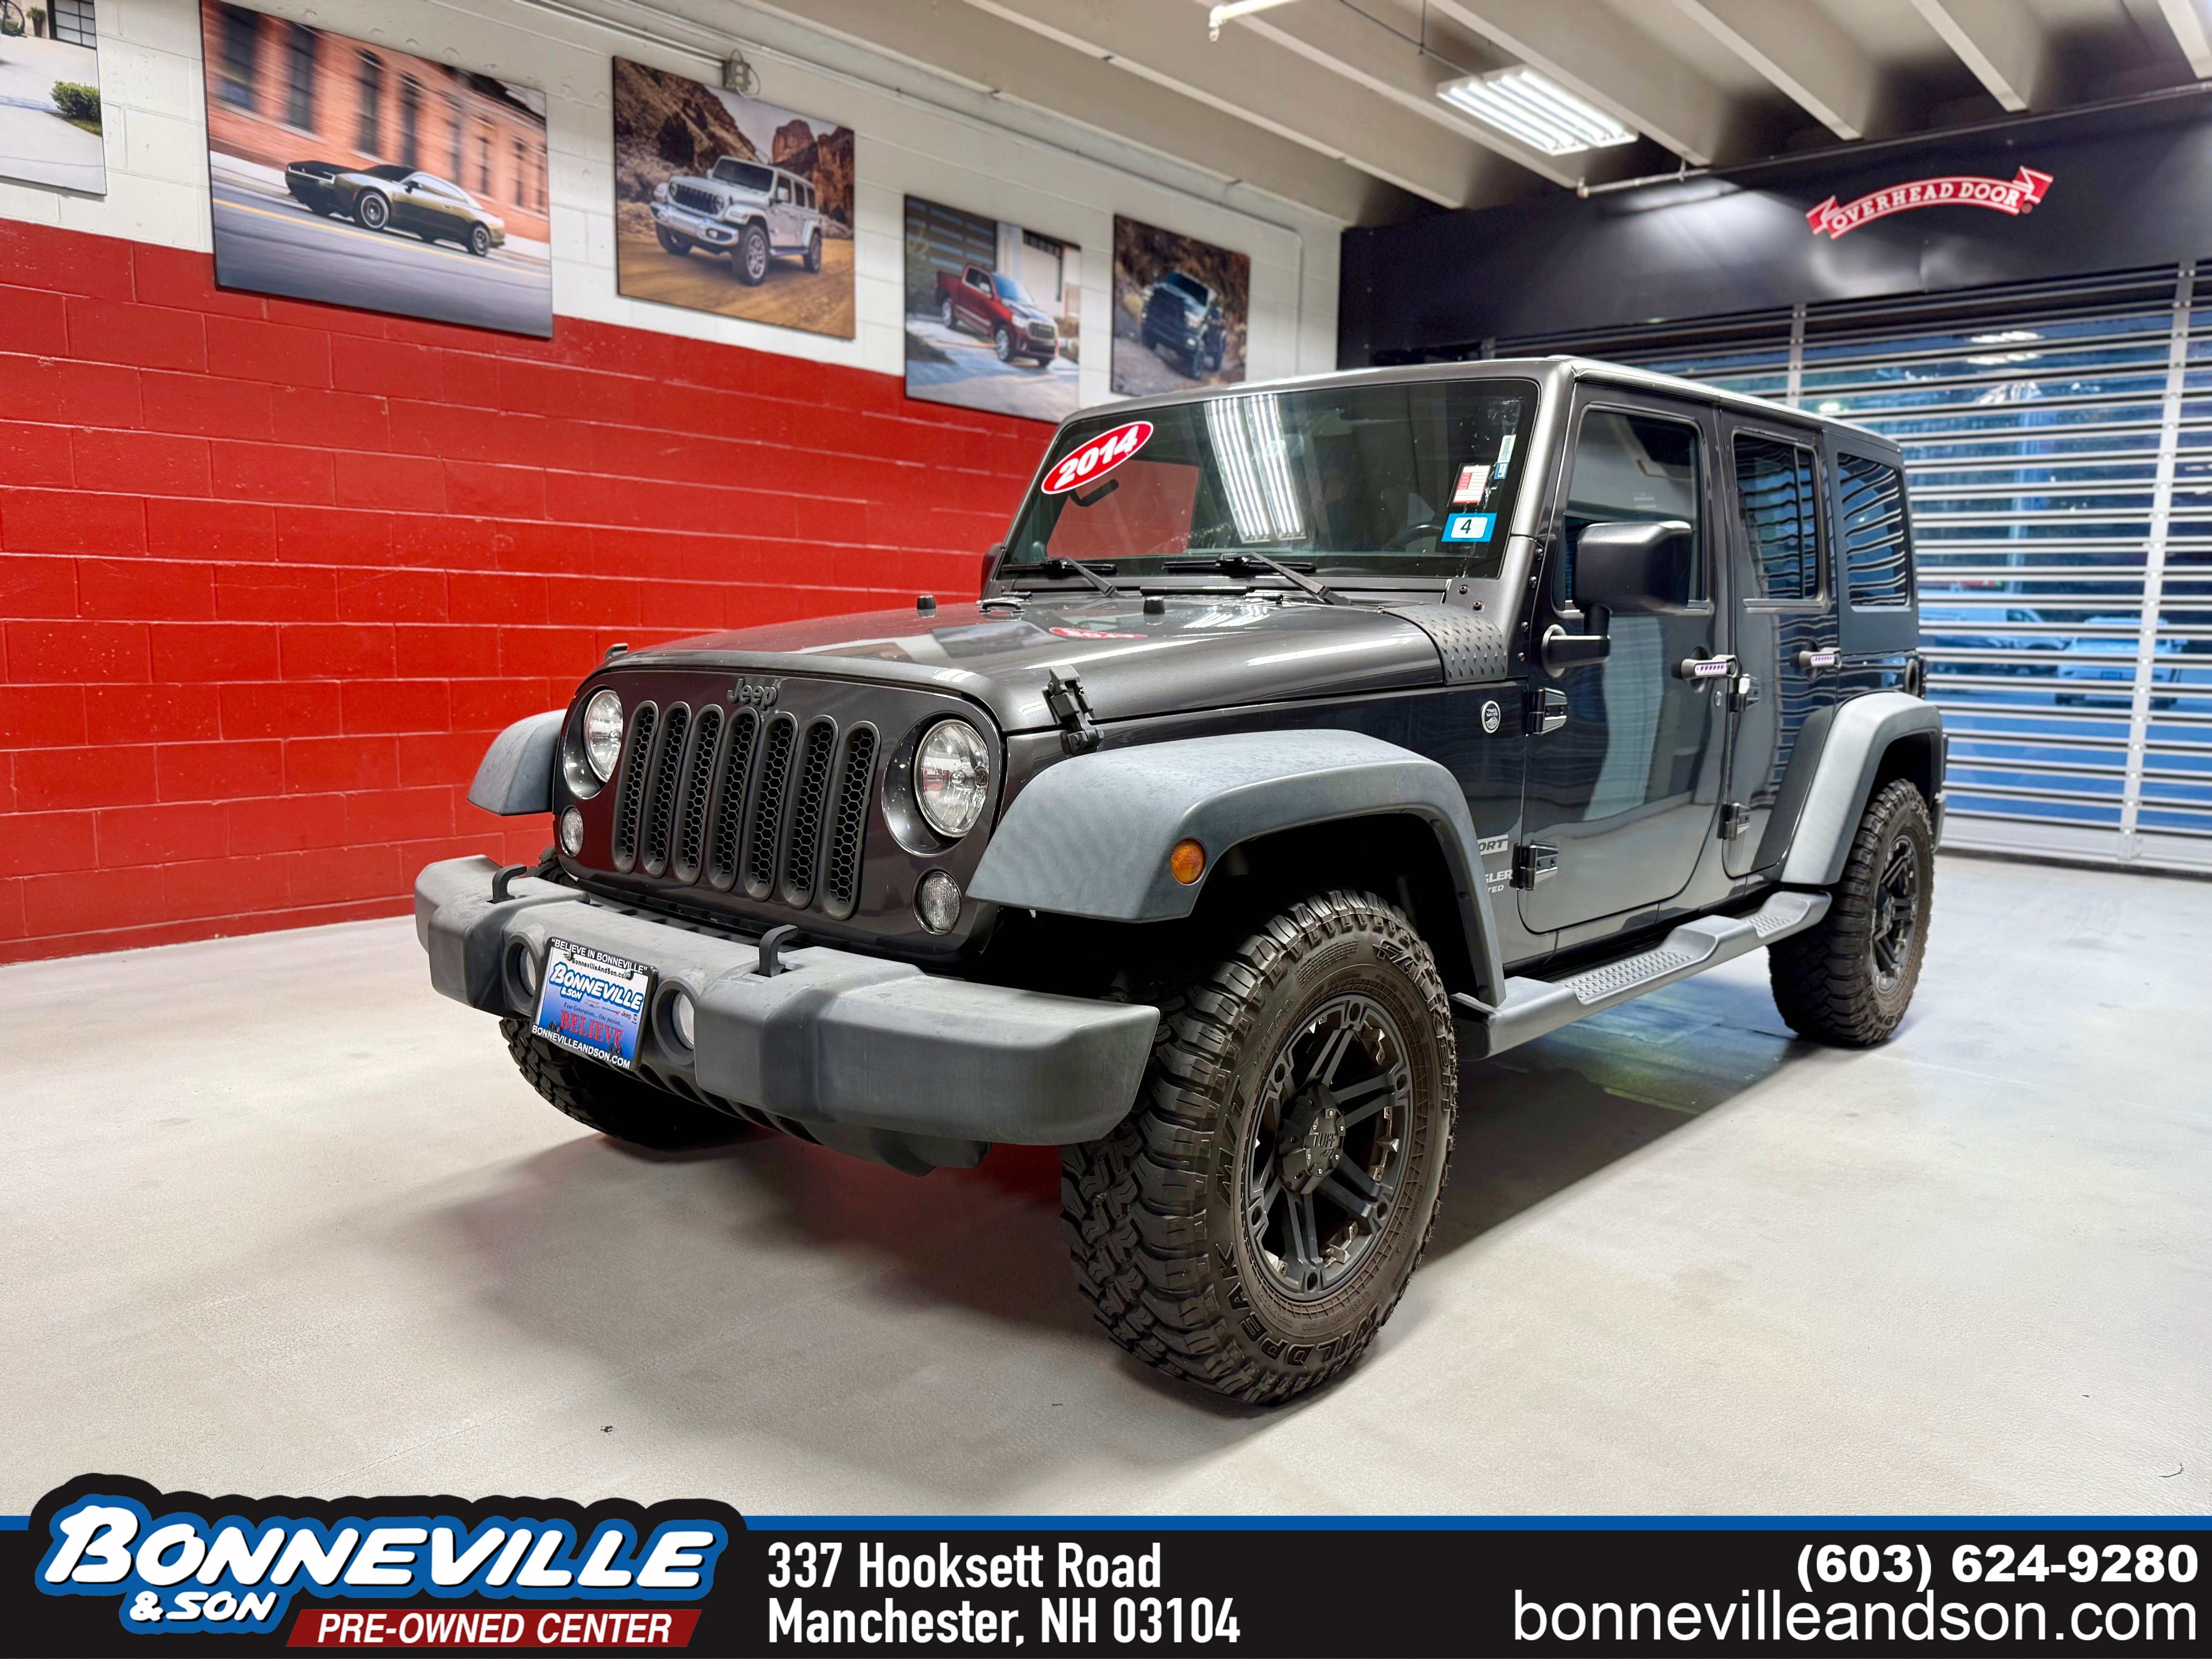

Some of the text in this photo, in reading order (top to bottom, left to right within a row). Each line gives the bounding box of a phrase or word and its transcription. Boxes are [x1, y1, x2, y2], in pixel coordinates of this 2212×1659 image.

[1832, 182, 2020, 230] OVERHEAD DOOR
[1054, 425, 1139, 489] 2014
[1460, 519, 1472, 534] 4
[727, 678, 778, 711] Jeep
[587, 949, 595, 959] IN
[550, 963, 643, 1010] BONNEVILLE
[560, 1010, 624, 1049] BELIEVE
[621, 1010, 632, 1020] Jeep
[532, 1024, 631, 1069] BONNEVILLEANDSON.COM
[1215, 1242, 1382, 1366] WILDPEAK
